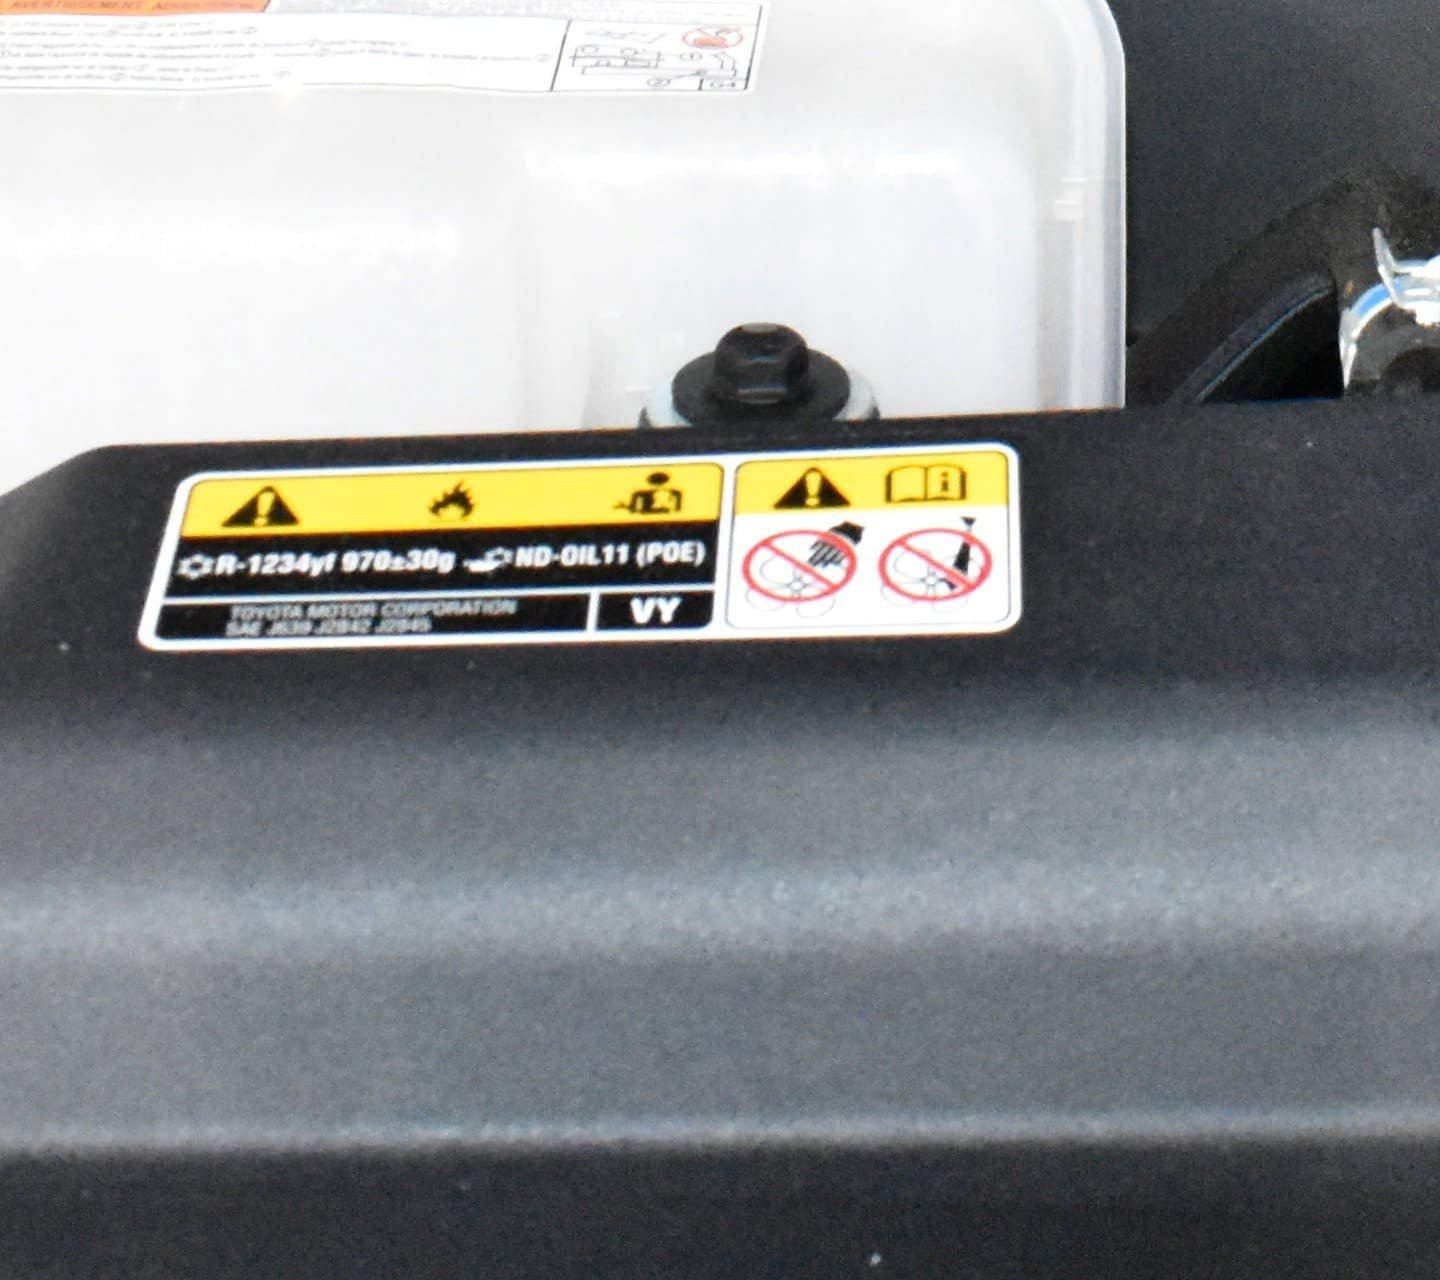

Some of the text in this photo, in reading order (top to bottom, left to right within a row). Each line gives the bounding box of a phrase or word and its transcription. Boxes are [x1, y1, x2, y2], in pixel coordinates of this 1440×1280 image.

[215, 539, 706, 578] R-1234yf 970±30g ND-OIL11 (POE)
[230, 599, 519, 620] TOYOTA MOTOR CORPORATION
[629, 596, 682, 625] VY
